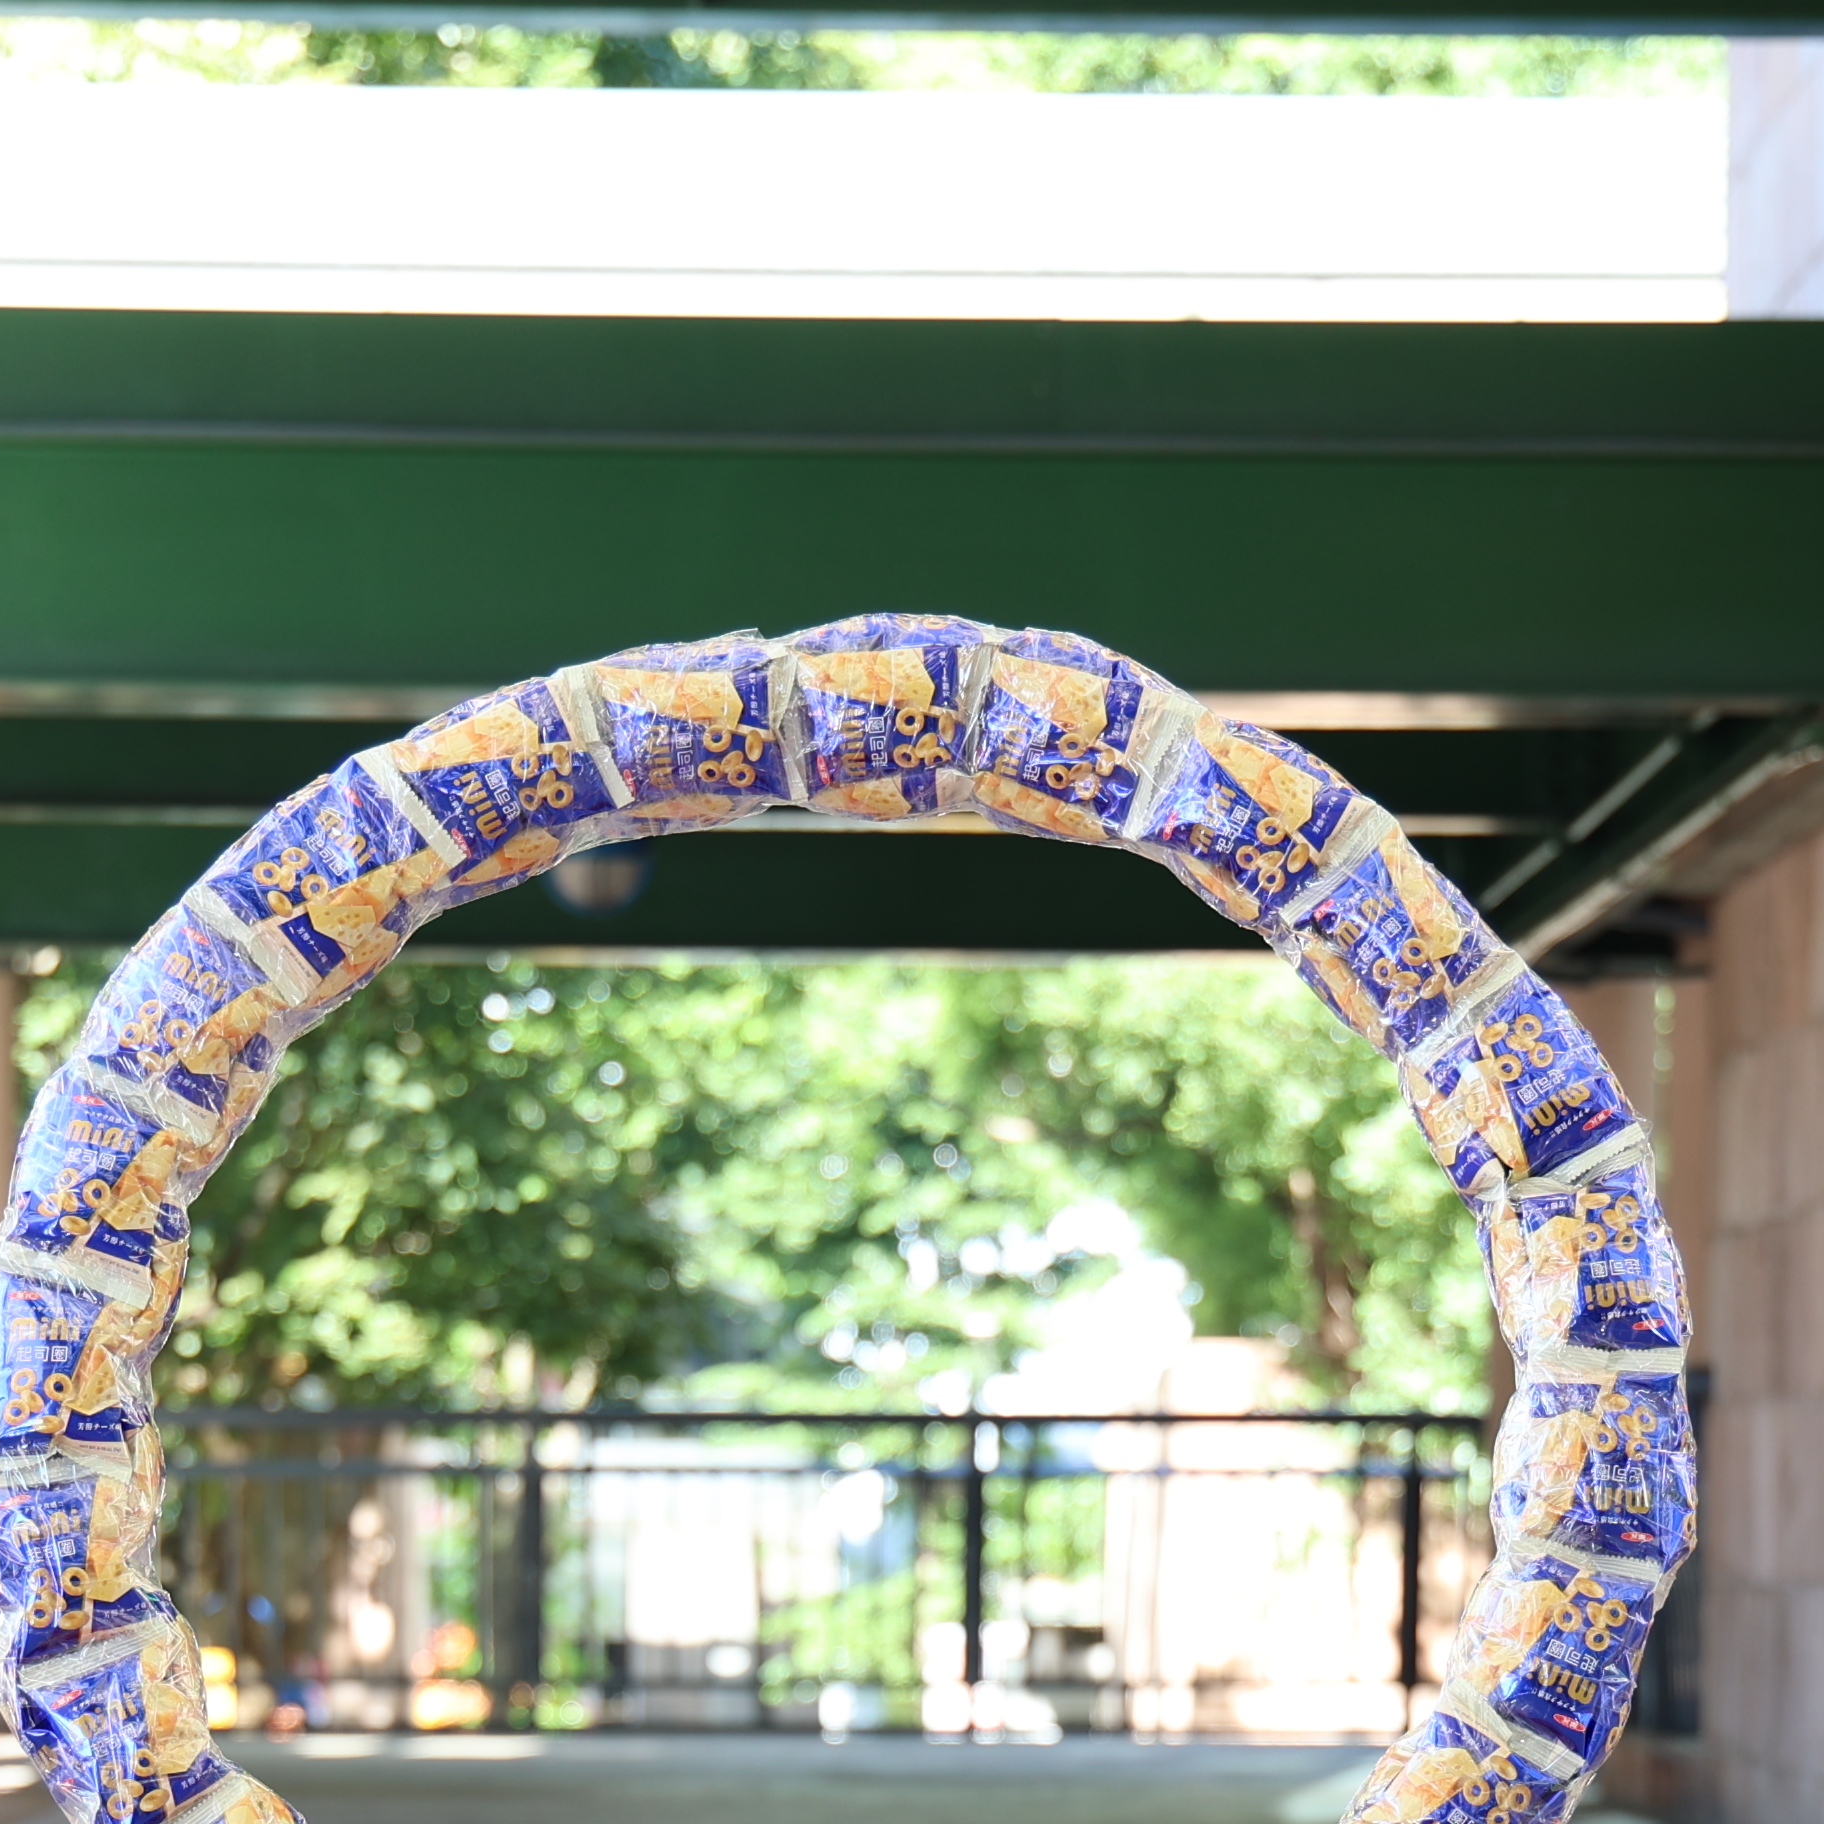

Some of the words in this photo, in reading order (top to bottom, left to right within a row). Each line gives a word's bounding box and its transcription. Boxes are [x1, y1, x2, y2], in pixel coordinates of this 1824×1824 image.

[453, 770, 509, 840] mini
[161, 952, 231, 1001] mini
[1522, 1082, 1591, 1136] mini
[64, 1119, 136, 1153] mini
[1584, 1279, 1655, 1310] mini
[10, 1316, 81, 1341] mini
[15, 1345, 68, 1363] 起司圈
[1547, 1639, 1599, 1674] 起司圈
[1526, 1656, 1597, 1704] mini
